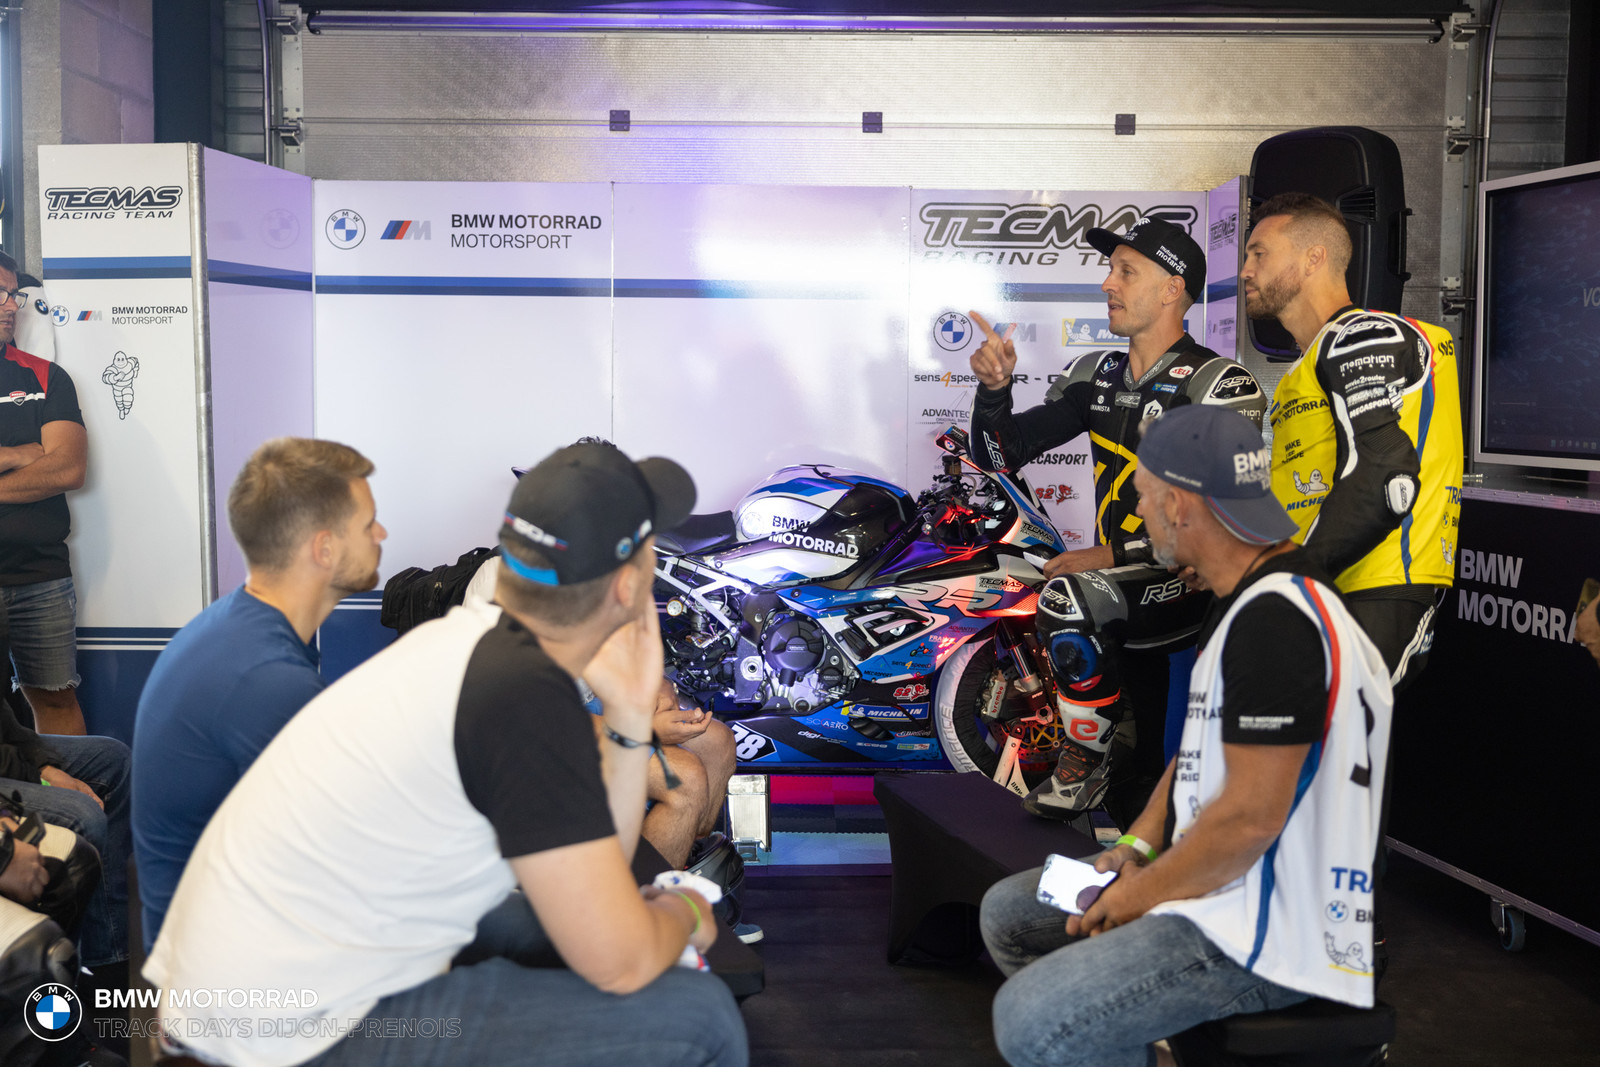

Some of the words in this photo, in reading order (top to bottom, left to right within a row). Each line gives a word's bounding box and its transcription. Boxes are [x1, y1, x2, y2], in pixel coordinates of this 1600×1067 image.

[45, 186, 183, 211] TECMAS
[47, 211, 115, 220] RACING
[124, 211, 173, 219] TEAM
[451, 214, 495, 228] BMW
[499, 214, 602, 229] MOTORRAD
[451, 233, 572, 249] MOTORSPORT
[1155, 249, 1184, 275] motards
[111, 306, 134, 315] BMW
[136, 306, 188, 314] MOTORRAD
[111, 316, 173, 325] MOTORSPORT
[914, 371, 980, 388] sens4spee
[1213, 375, 1254, 395] RST
[772, 515, 811, 533] BMW
[768, 531, 859, 558] MOTORRAD
[1460, 548, 1523, 589] BMW
[1140, 578, 1192, 604] RS
[894, 687, 911, 697] S2
[991, 686, 1004, 713] brembo
[867, 708, 923, 717] MICHEIN
